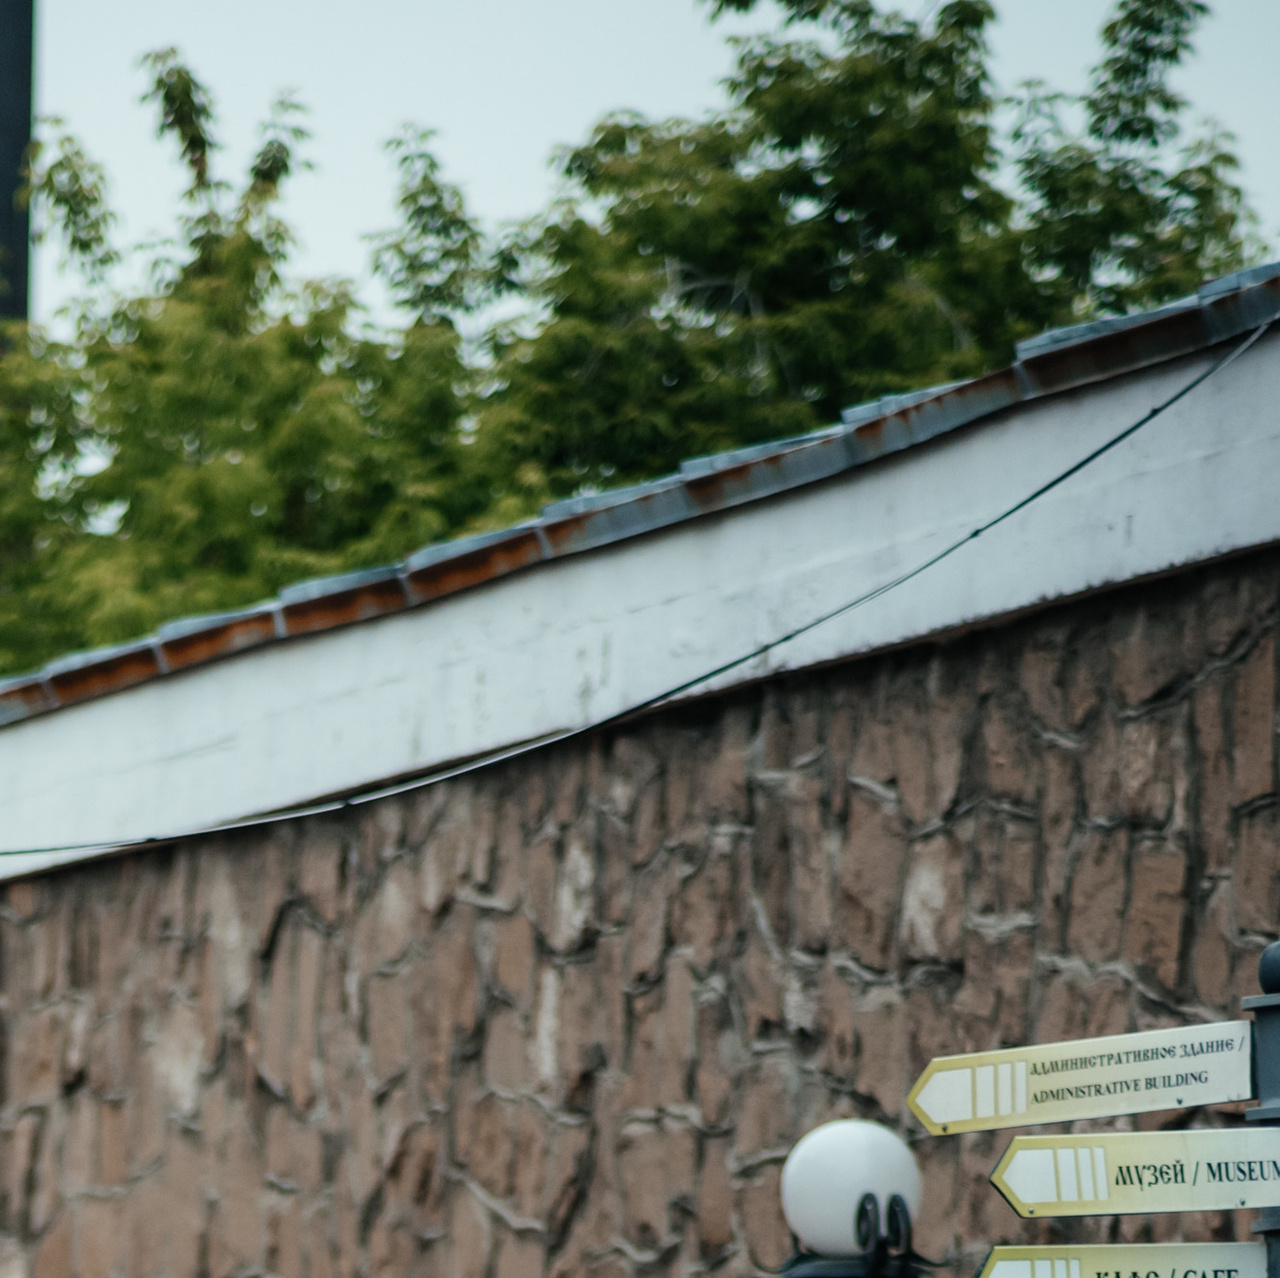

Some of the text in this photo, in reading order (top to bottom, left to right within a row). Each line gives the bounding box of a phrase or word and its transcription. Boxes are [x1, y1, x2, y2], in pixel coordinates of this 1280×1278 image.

[1179, 1038, 1234, 1058] ЗДАНИЕ
[1238, 1036, 1245, 1052] /
[1031, 1070, 1209, 1104] ADMINISTRATIVE BUILDING
[1115, 1160, 1186, 1191] МУЗЕЙ
[1192, 1161, 1200, 1186] /
